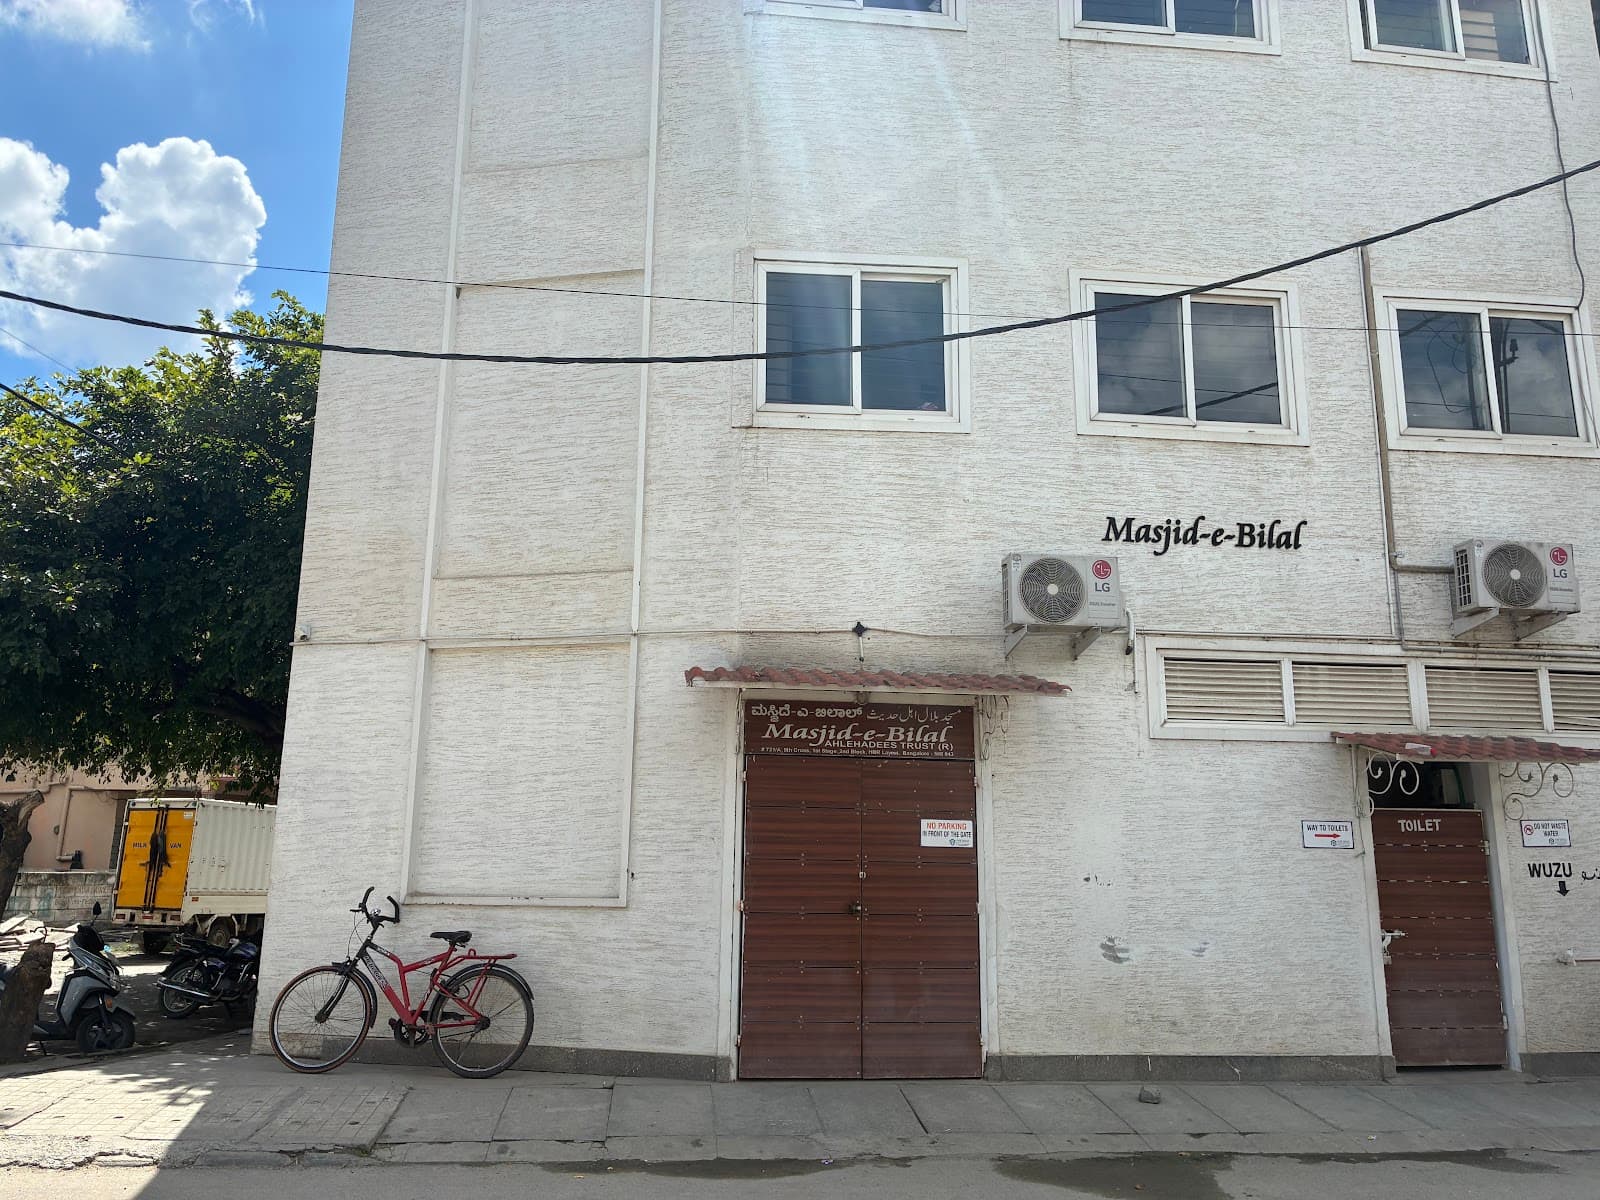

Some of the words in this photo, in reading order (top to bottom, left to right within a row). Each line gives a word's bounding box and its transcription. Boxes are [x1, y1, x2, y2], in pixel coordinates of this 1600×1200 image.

[1101, 515, 1307, 556] Masjid-e-Bilal
[1553, 568, 1568, 578] LG
[1094, 582, 1111, 592] LG
[761, 723, 953, 747] Masjid-e-Bilal
[824, 740, 897, 749] AHLEHADEES
[900, 742, 936, 750] TRUST
[938, 742, 954, 752] (R)
[927, 822, 936, 830] NO
[1398, 819, 1442, 832] TOILET
[1527, 862, 1573, 878] WUZU
